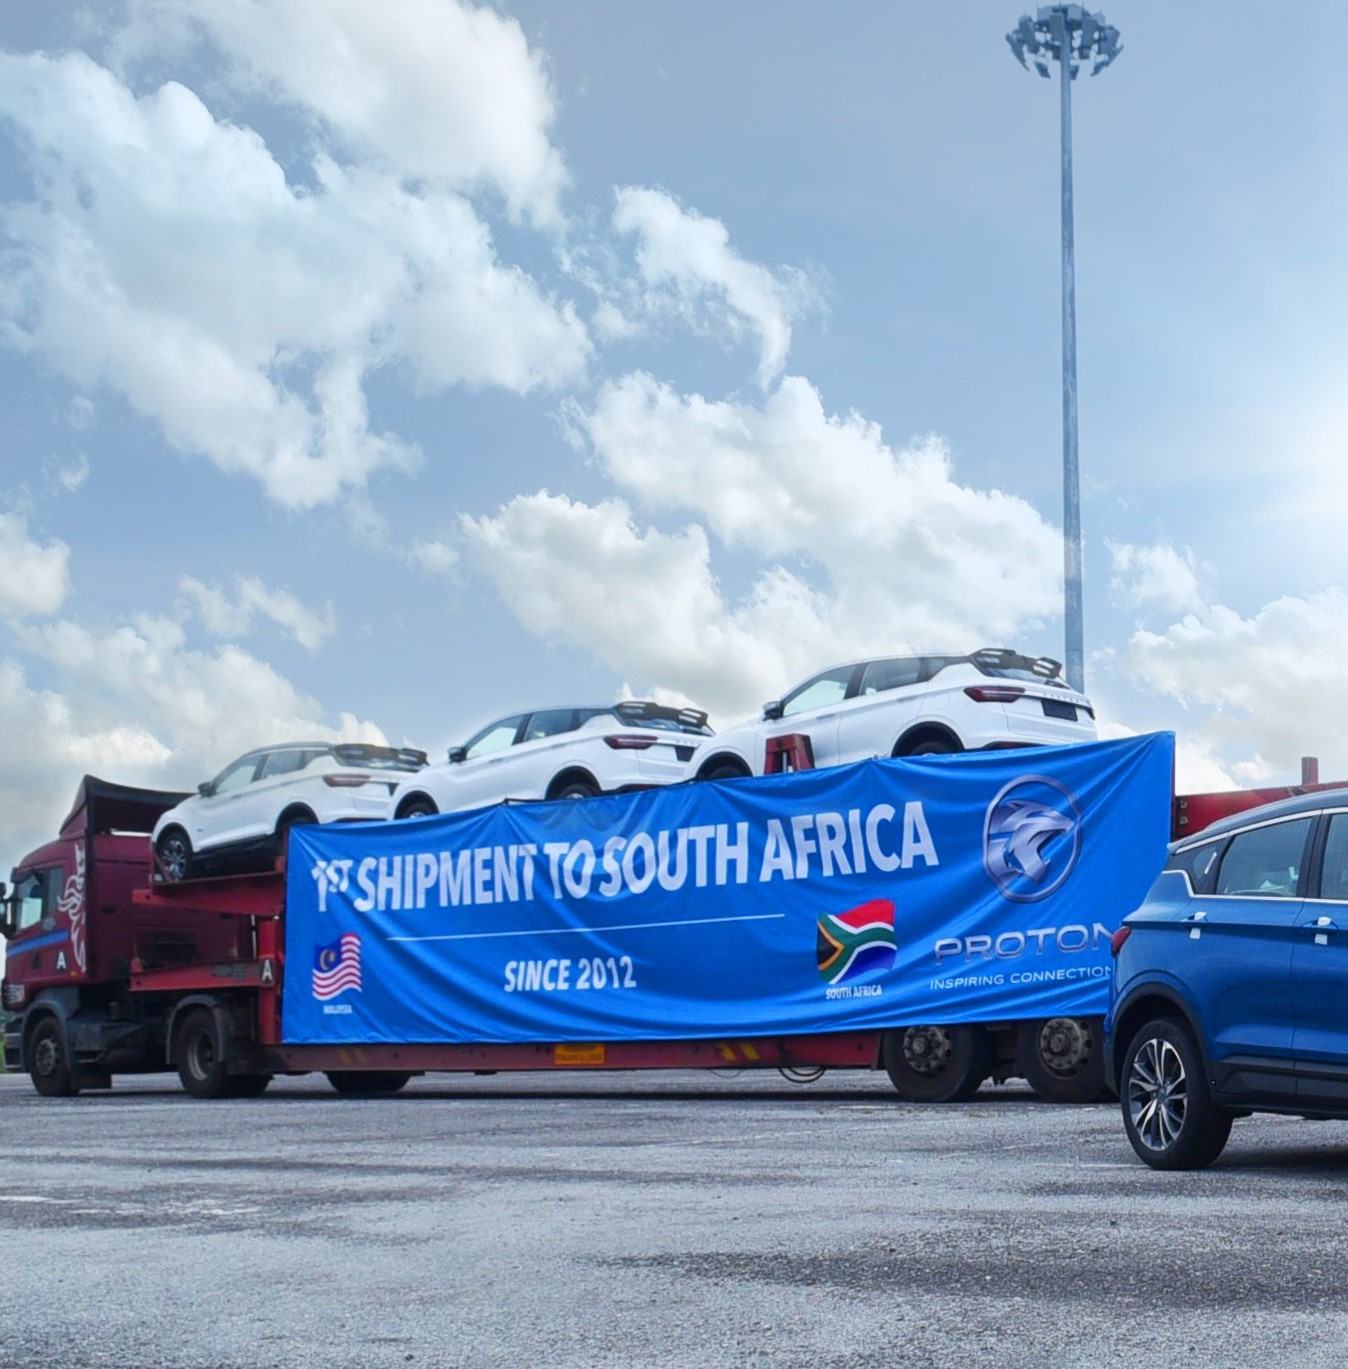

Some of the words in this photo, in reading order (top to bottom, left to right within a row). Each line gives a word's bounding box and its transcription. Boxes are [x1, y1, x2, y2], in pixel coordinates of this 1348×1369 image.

[311, 859, 353, 912] 1ST
[353, 844, 538, 912] SHIPMENT
[544, 839, 596, 900] TO
[599, 821, 749, 897] SOUTH
[759, 801, 939, 882] AFRICA
[934, 922, 1112, 966] PROTON
[56, 951, 67, 970] A
[261, 959, 273, 981] A
[503, 960, 571, 992] SINCE
[576, 956, 637, 990] 2012
[929, 975, 1004, 990] INSPIRING
[825, 986, 852, 1000] SOUTH
[853, 984, 882, 998] AFRICA
